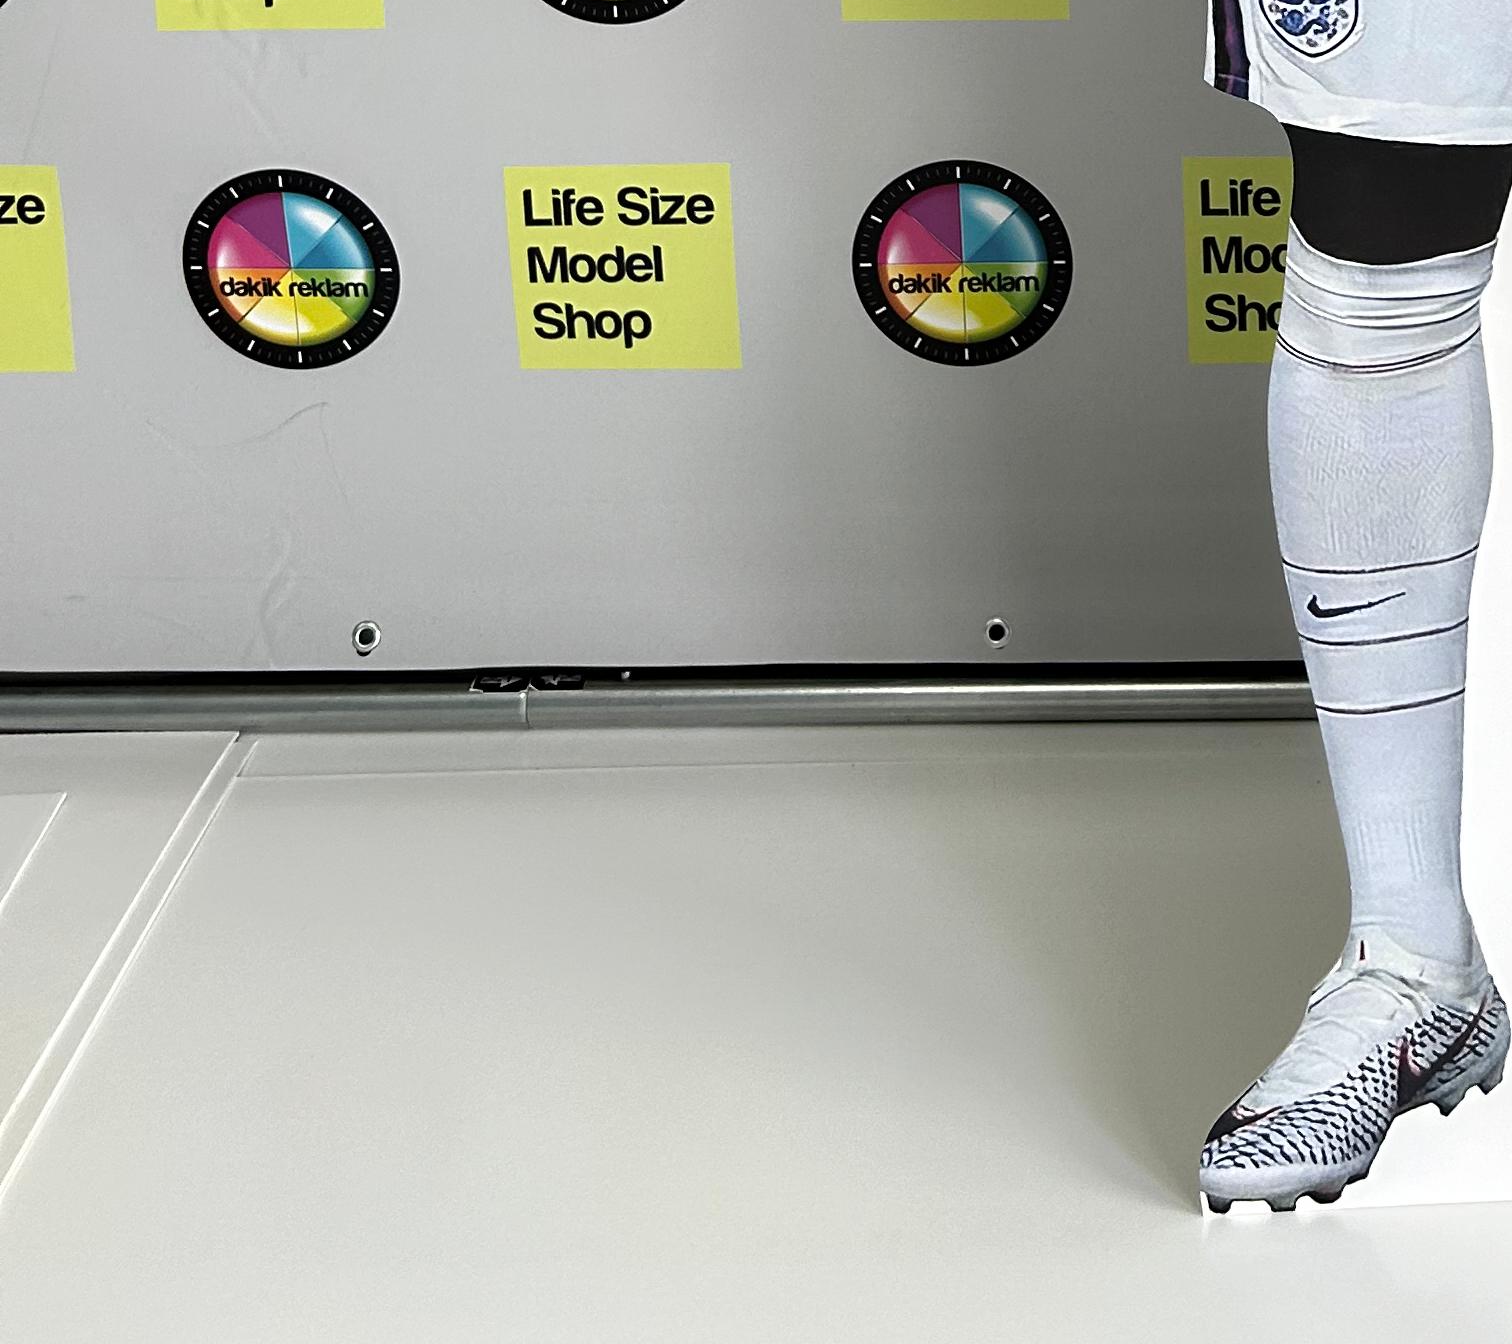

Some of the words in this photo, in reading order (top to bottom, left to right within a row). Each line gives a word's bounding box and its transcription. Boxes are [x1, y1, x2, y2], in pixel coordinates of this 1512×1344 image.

[0, 193, 46, 225] ze
[522, 188, 605, 227] Life
[617, 186, 715, 227] Size
[1200, 178, 1282, 218] Life
[526, 244, 664, 284] Model
[888, 273, 952, 294] dakik
[958, 272, 1040, 293] reklam
[219, 277, 283, 297] dakik
[288, 277, 370, 298] reklam
[533, 302, 652, 349] Shop
